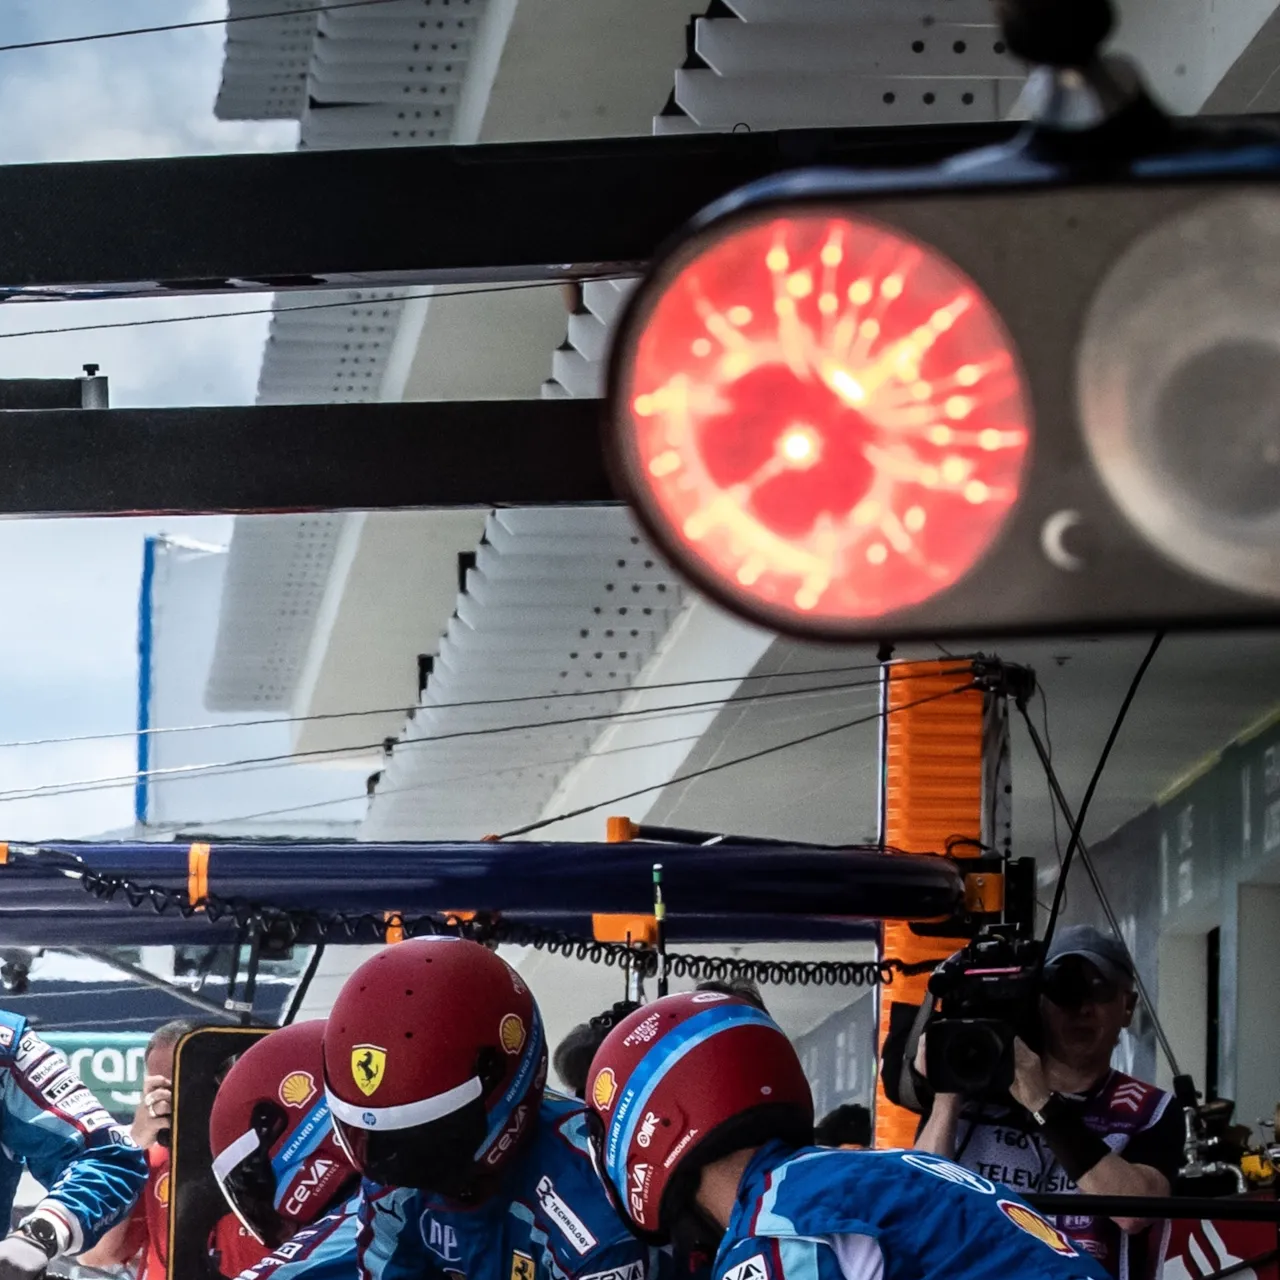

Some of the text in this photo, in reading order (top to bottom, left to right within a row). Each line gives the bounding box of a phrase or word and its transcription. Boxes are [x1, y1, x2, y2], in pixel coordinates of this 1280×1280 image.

[623, 1012, 661, 1047] PERONI
[362, 1112, 377, 1126] hp
[608, 1088, 635, 1168] RICHARD MILLE
[282, 1124, 314, 1162] RICHARD
[550, 1201, 590, 1249] TECHNOLOGY
